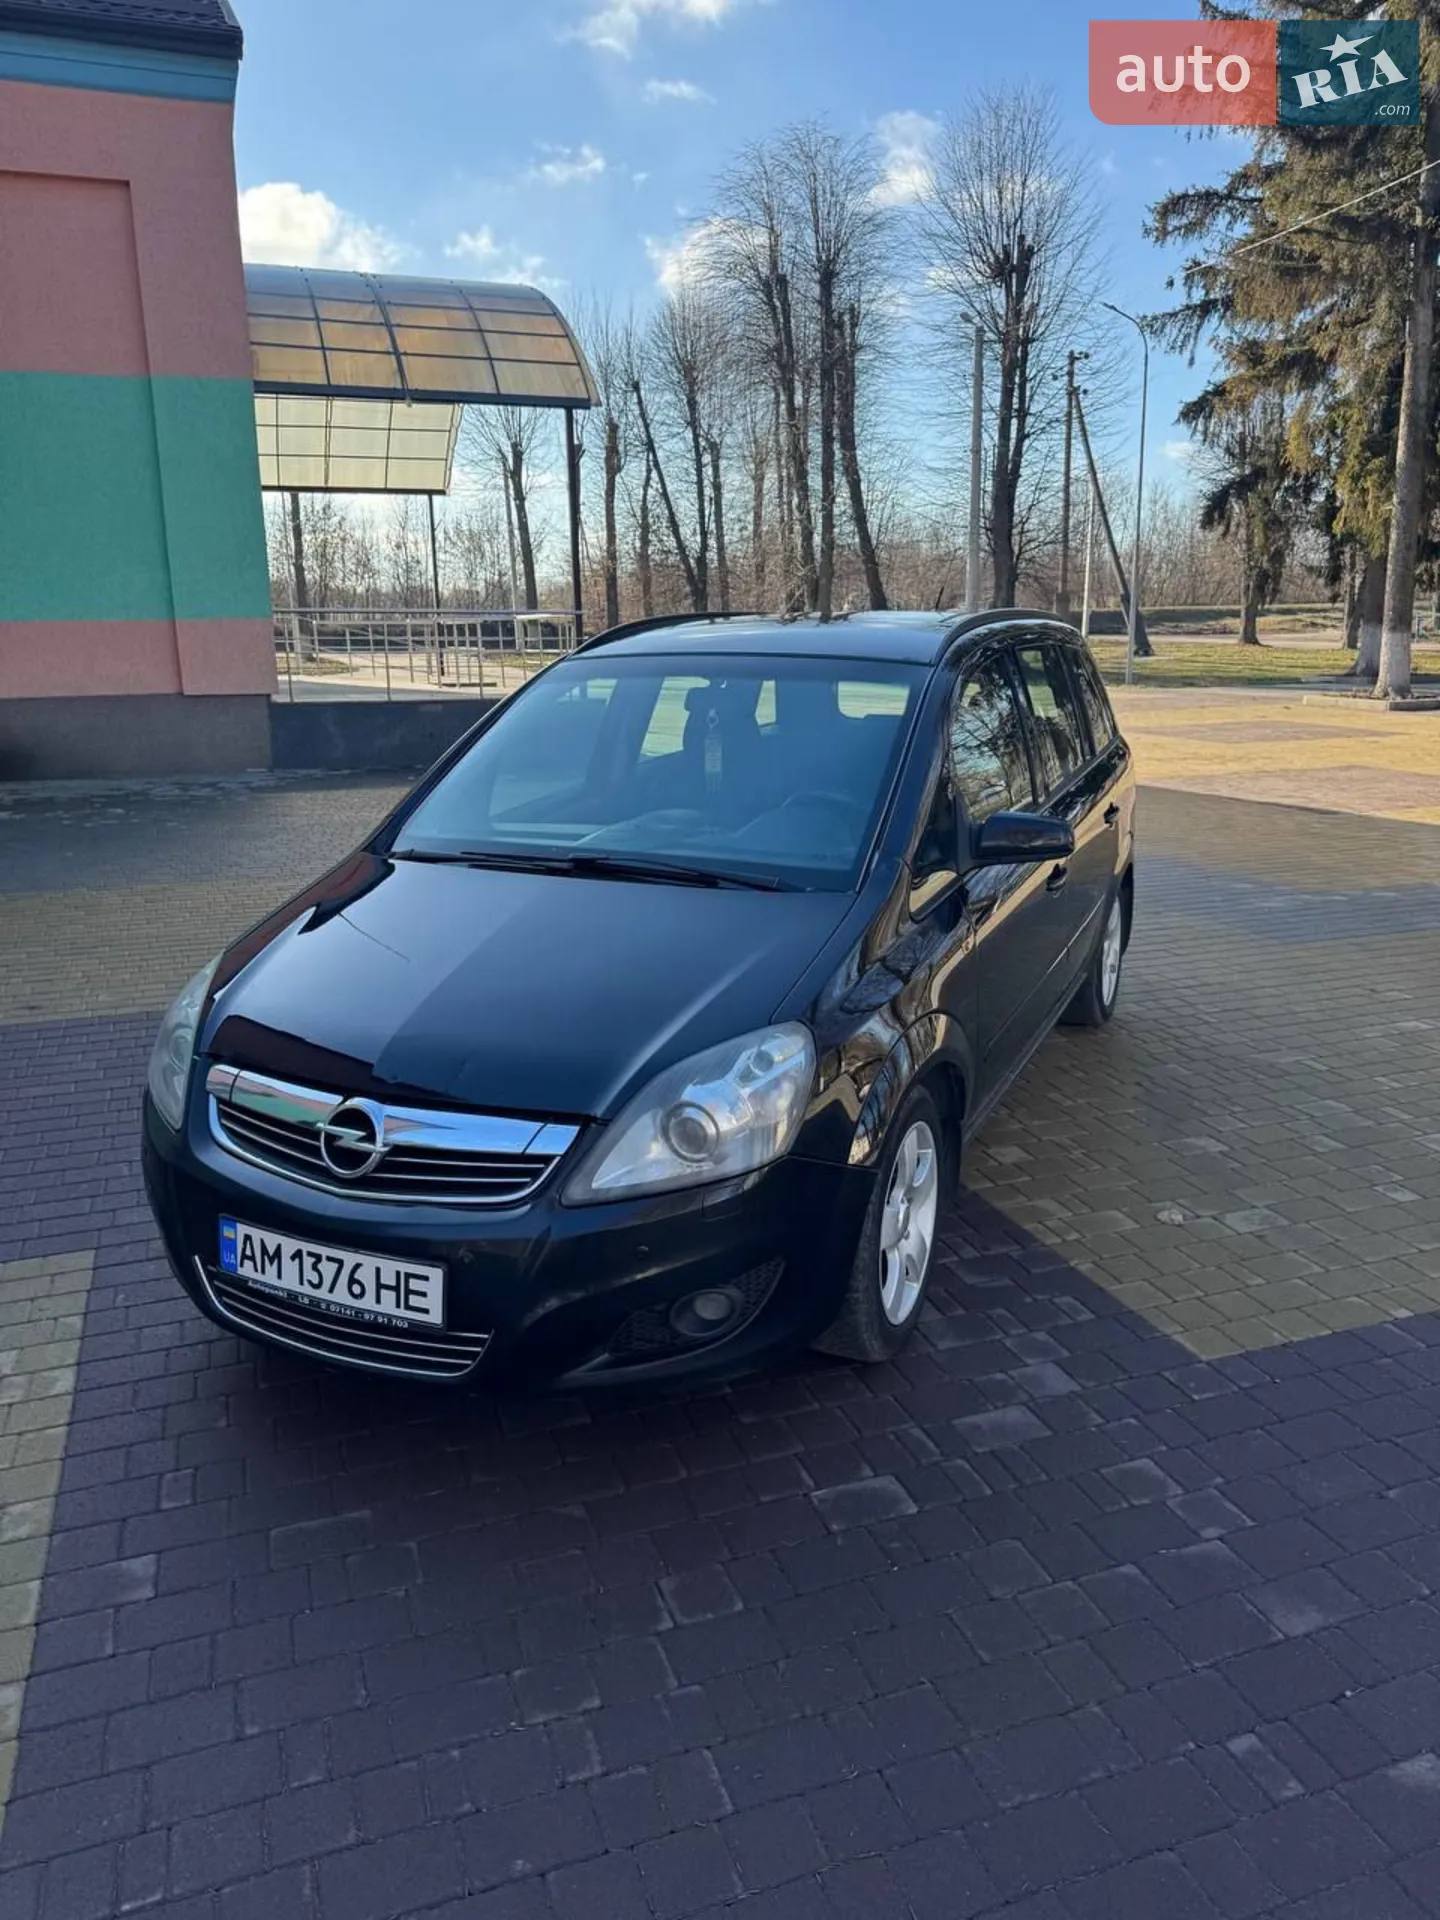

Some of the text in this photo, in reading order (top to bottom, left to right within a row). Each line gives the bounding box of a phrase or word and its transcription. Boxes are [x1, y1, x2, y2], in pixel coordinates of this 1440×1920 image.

[224, 1251, 236, 1265] UA
[239, 1233, 430, 1314] AM 1376 HE
